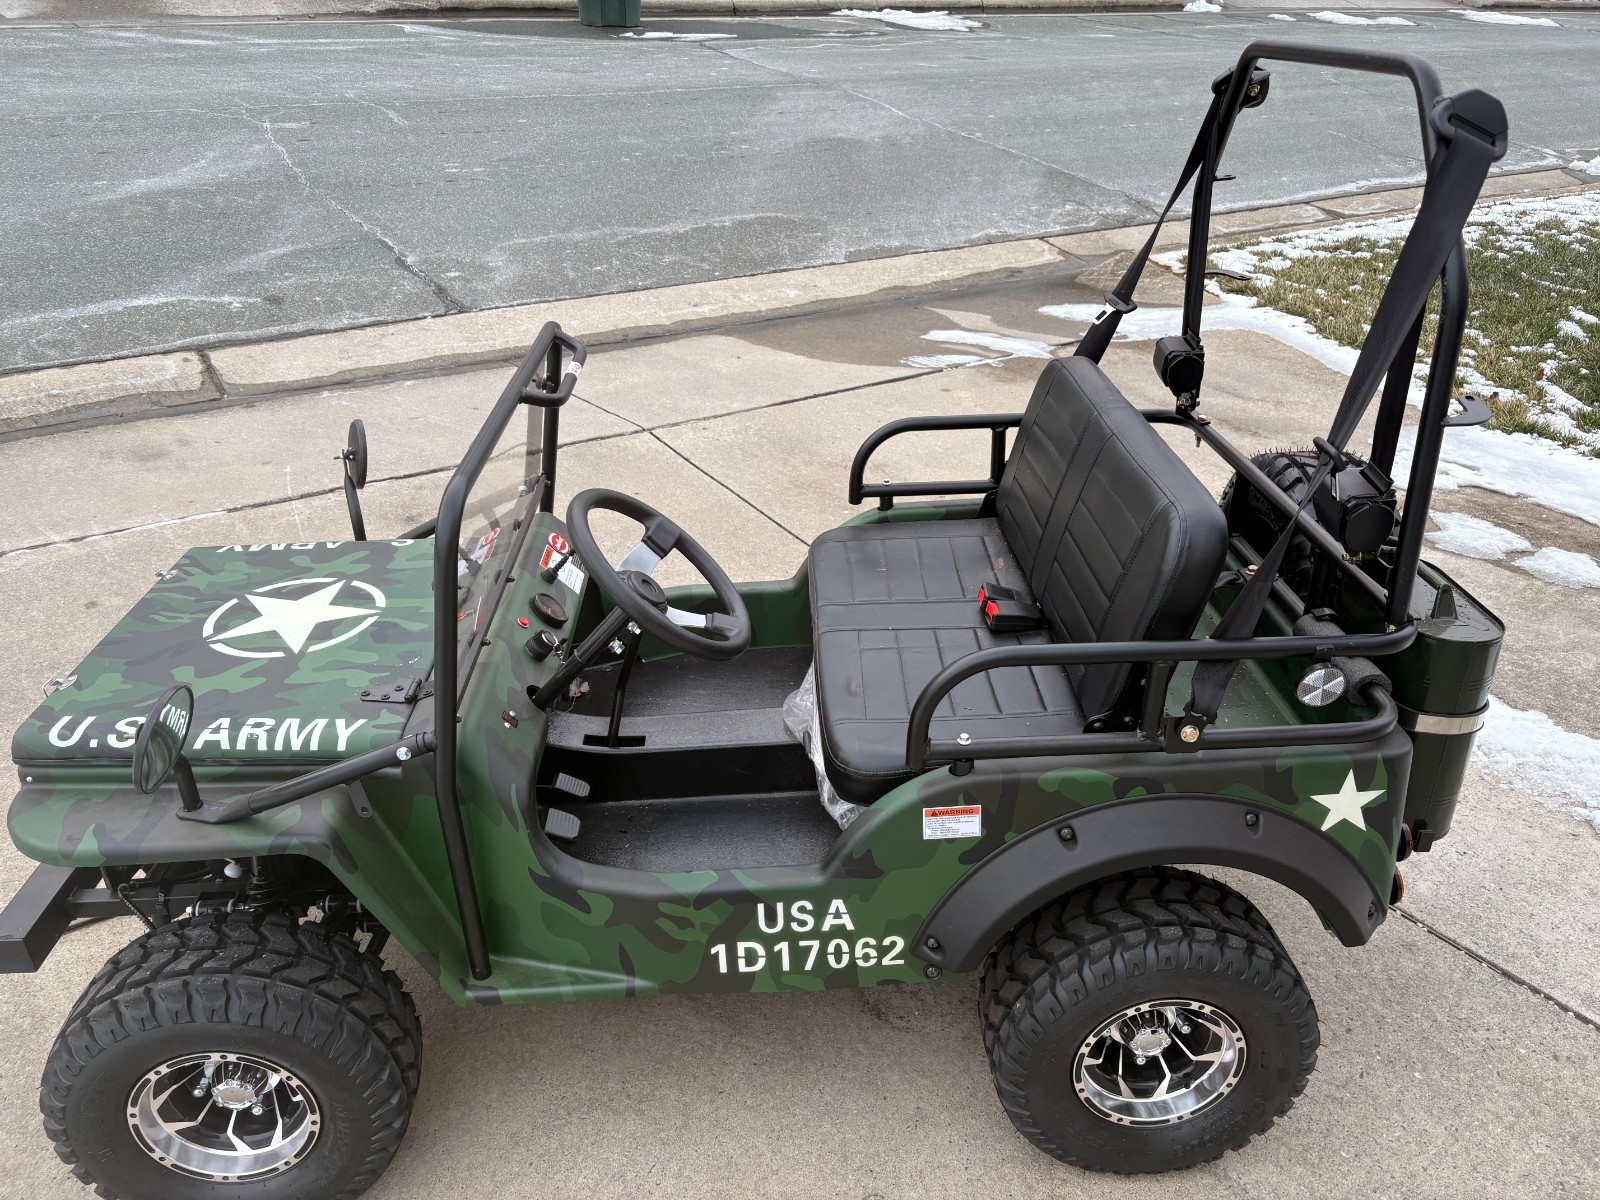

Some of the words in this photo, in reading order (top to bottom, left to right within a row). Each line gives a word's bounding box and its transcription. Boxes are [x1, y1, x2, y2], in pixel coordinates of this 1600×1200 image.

[192, 717, 369, 751] ARMY
[937, 808, 974, 816] WARNING
[757, 898, 855, 934] USA
[710, 935, 905, 974] 1D17062
